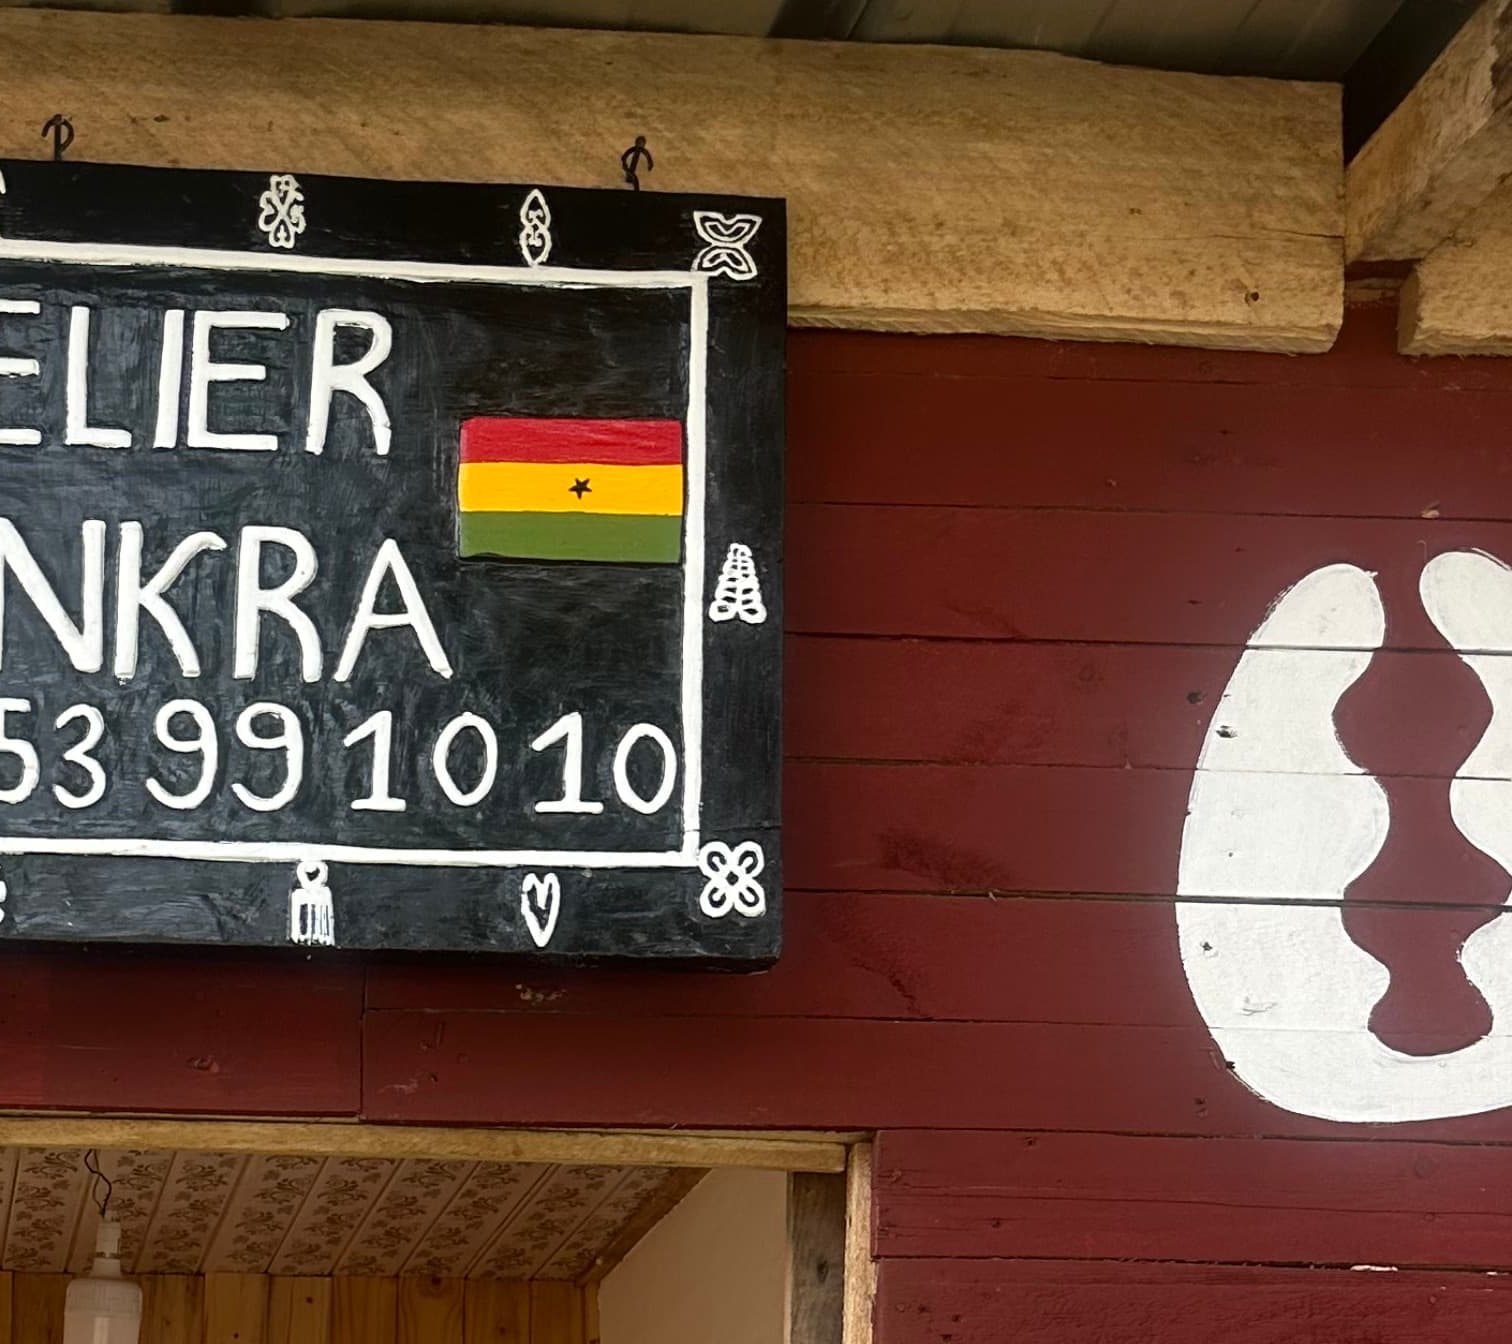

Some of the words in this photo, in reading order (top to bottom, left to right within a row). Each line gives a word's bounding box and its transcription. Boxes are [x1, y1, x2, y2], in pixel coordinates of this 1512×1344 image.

[144, 698, 305, 812] 99
[341, 710, 499, 813] 10
[527, 711, 679, 816] 10
